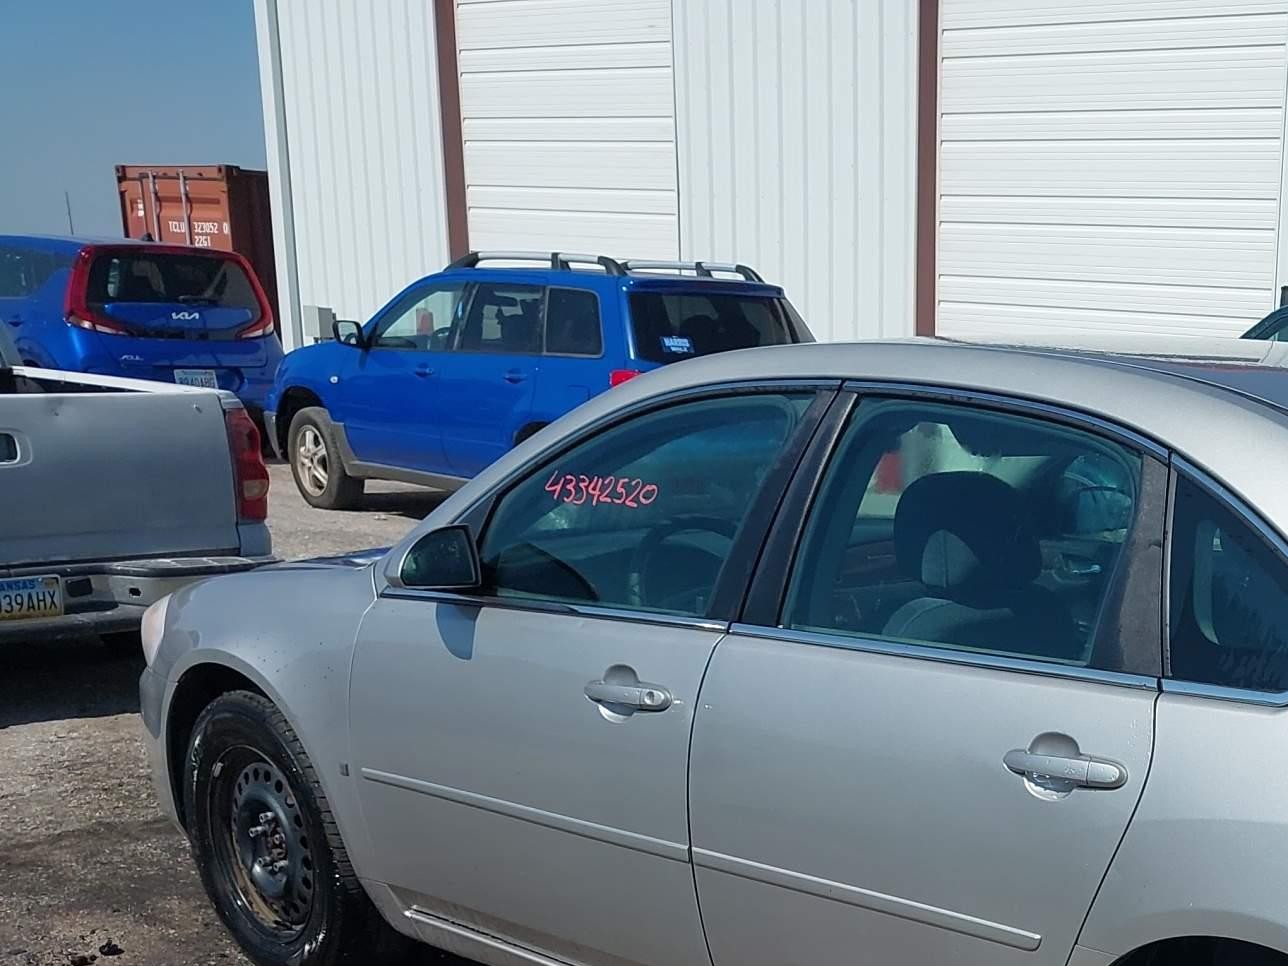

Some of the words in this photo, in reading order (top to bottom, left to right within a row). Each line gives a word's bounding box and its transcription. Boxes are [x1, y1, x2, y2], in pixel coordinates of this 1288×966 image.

[168, 221, 185, 232] TCLU
[193, 221, 218, 233] 323052
[545, 470, 658, 508] 43342520
[0, 580, 36, 592] ANSAS
[0, 590, 58, 614] 39AHX
